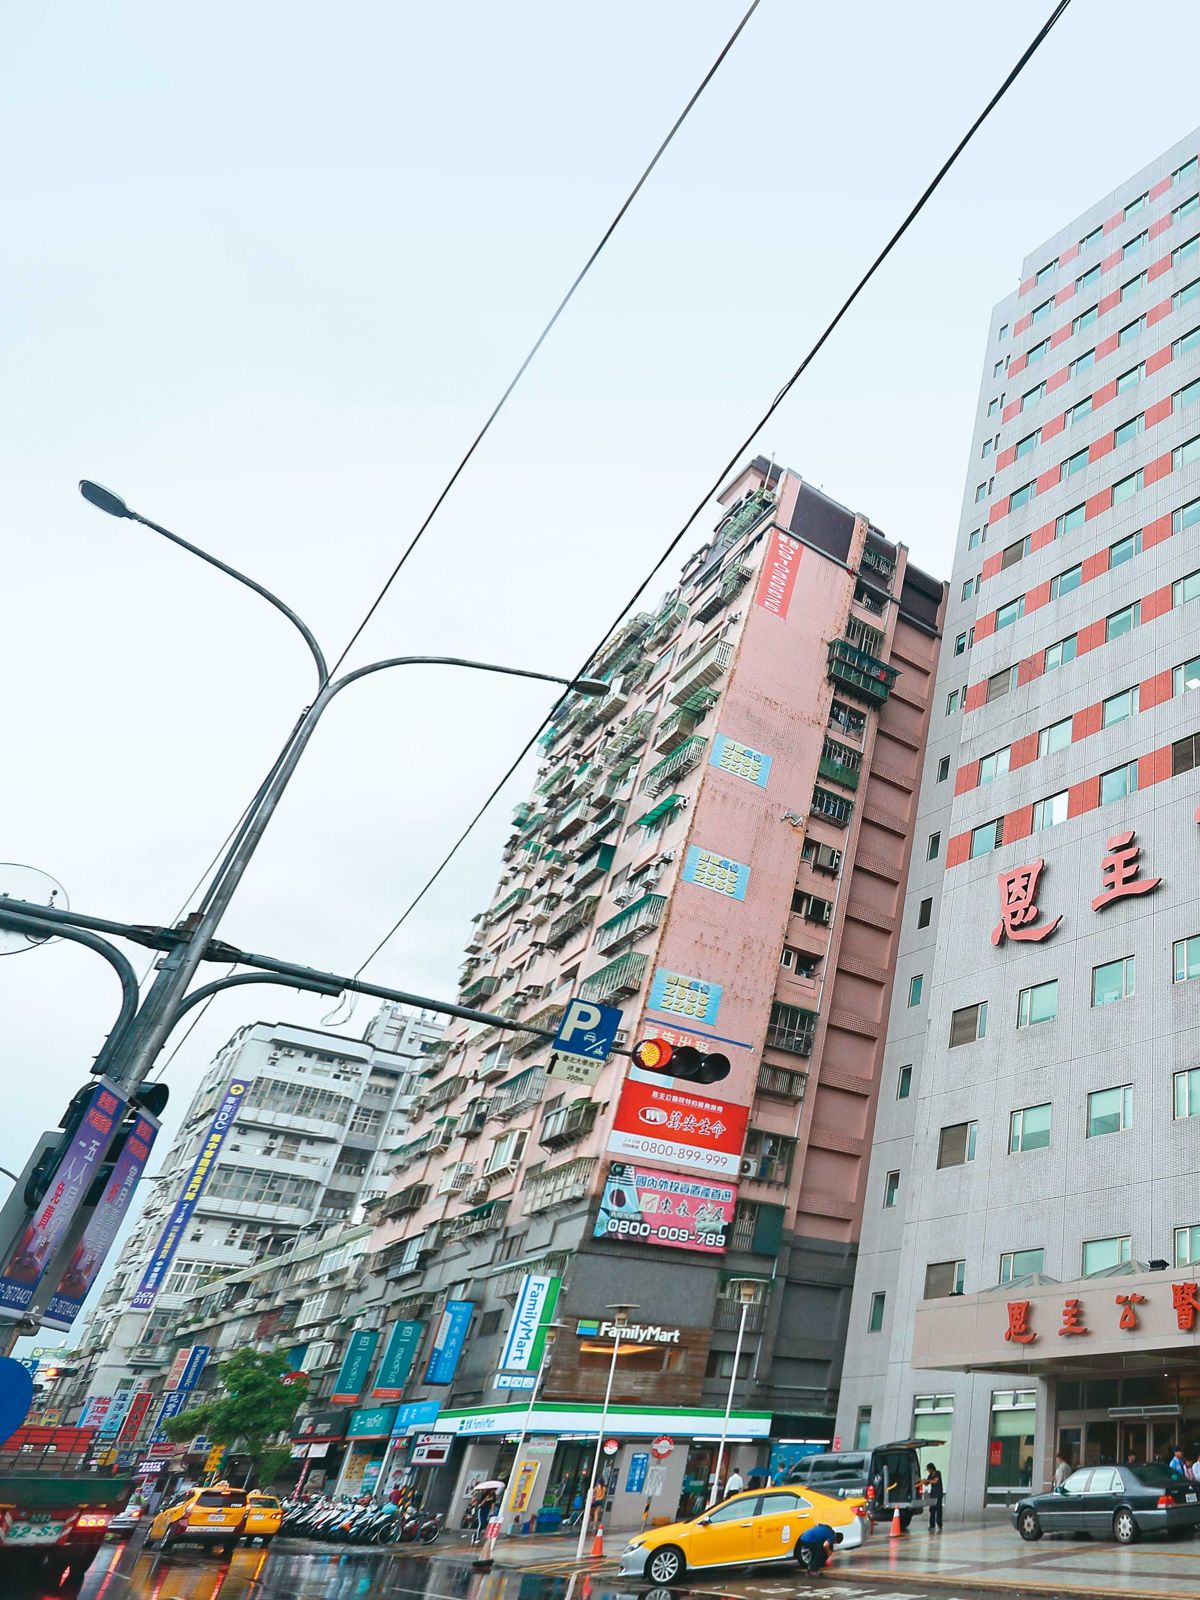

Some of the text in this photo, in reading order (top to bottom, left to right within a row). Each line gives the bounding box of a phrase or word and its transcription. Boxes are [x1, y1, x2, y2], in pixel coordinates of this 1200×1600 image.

[559, 1001, 601, 1042] P
[566, 1074, 584, 1082] 200m
[666, 1110, 727, 1139] 萬安生命
[640, 1140, 728, 1168] 0800-899-999
[607, 1219, 726, 1248] 0800-009-789
[513, 1283, 545, 1362] FamilyMart
[600, 1321, 680, 1344] FamilyMart
[184, 1349, 205, 1387] Panasonic
